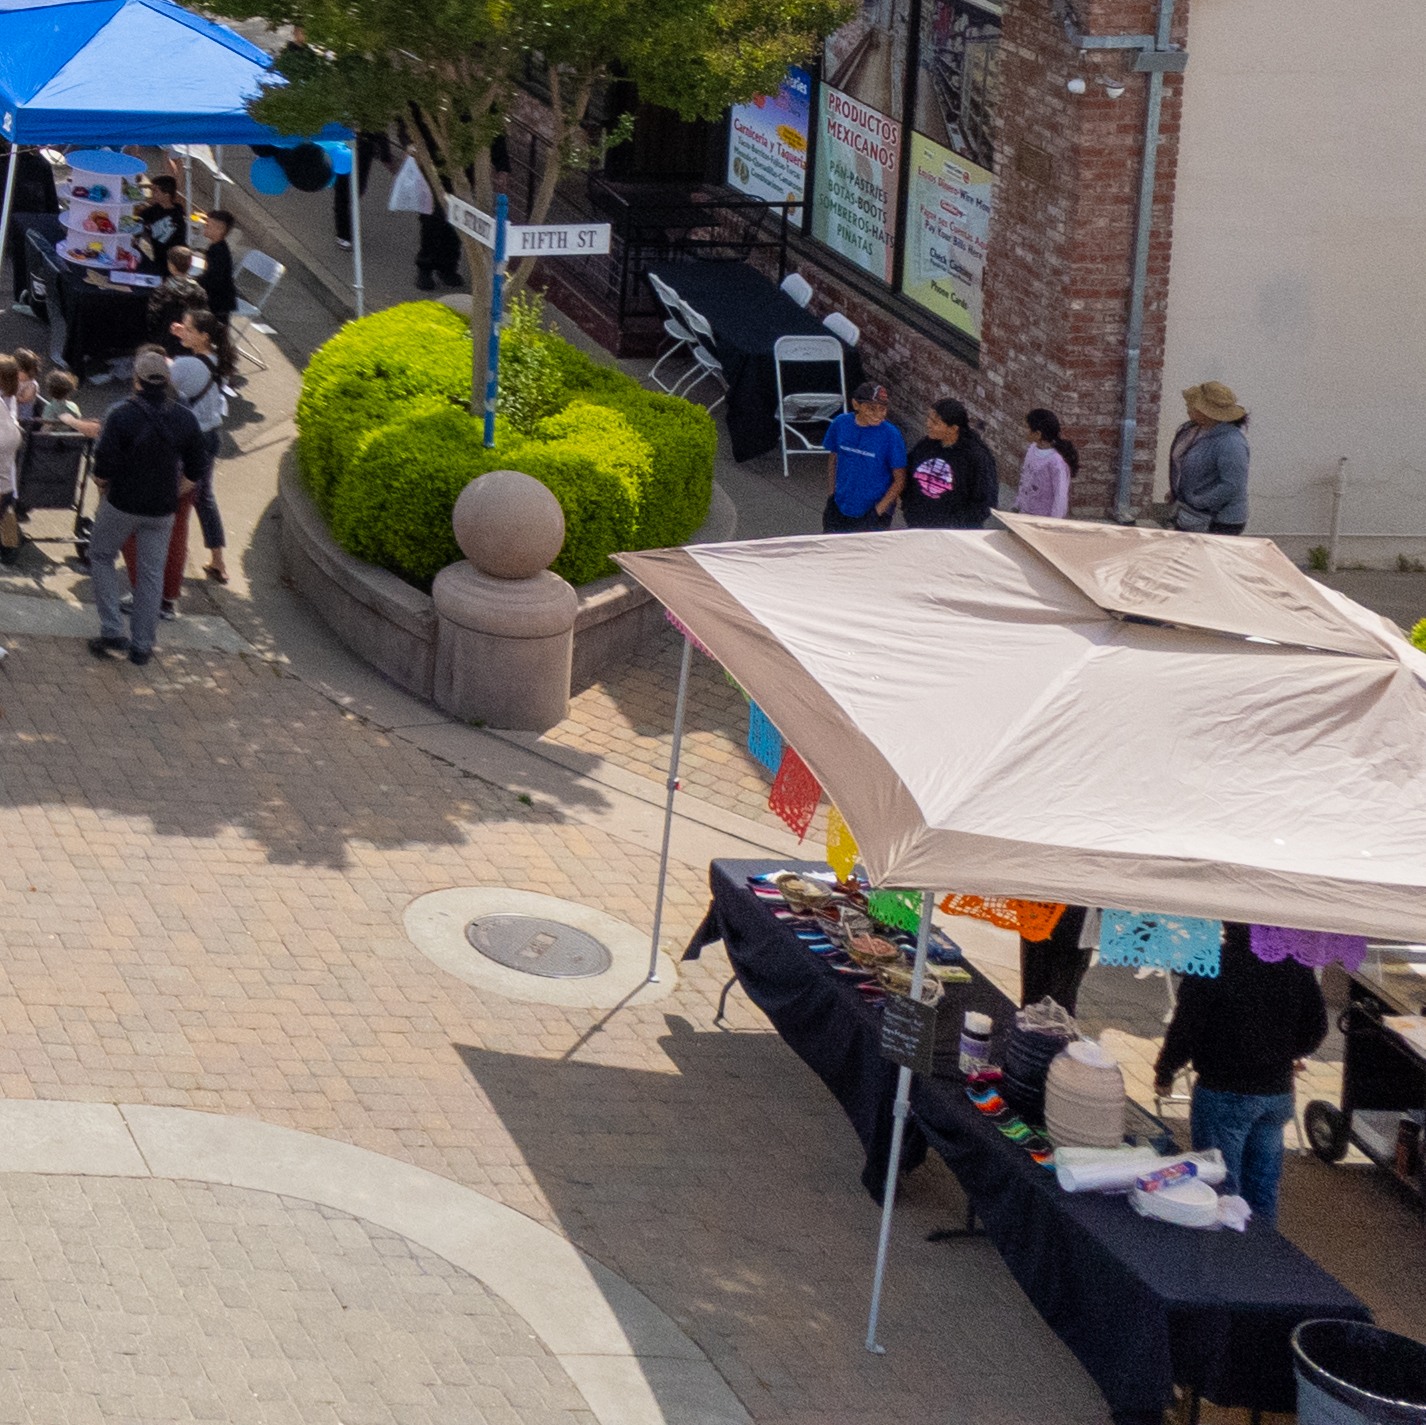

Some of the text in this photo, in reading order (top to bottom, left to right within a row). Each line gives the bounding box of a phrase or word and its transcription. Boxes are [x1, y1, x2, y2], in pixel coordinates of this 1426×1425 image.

[827, 117, 895, 170] MEXICANOS
[828, 93, 897, 145] PRODUCTOS
[819, 193, 895, 250] SOMBREROS-HATS
[828, 178, 887, 224] BOTAS-BOOTS
[522, 230, 597, 249] FIFTH ST
